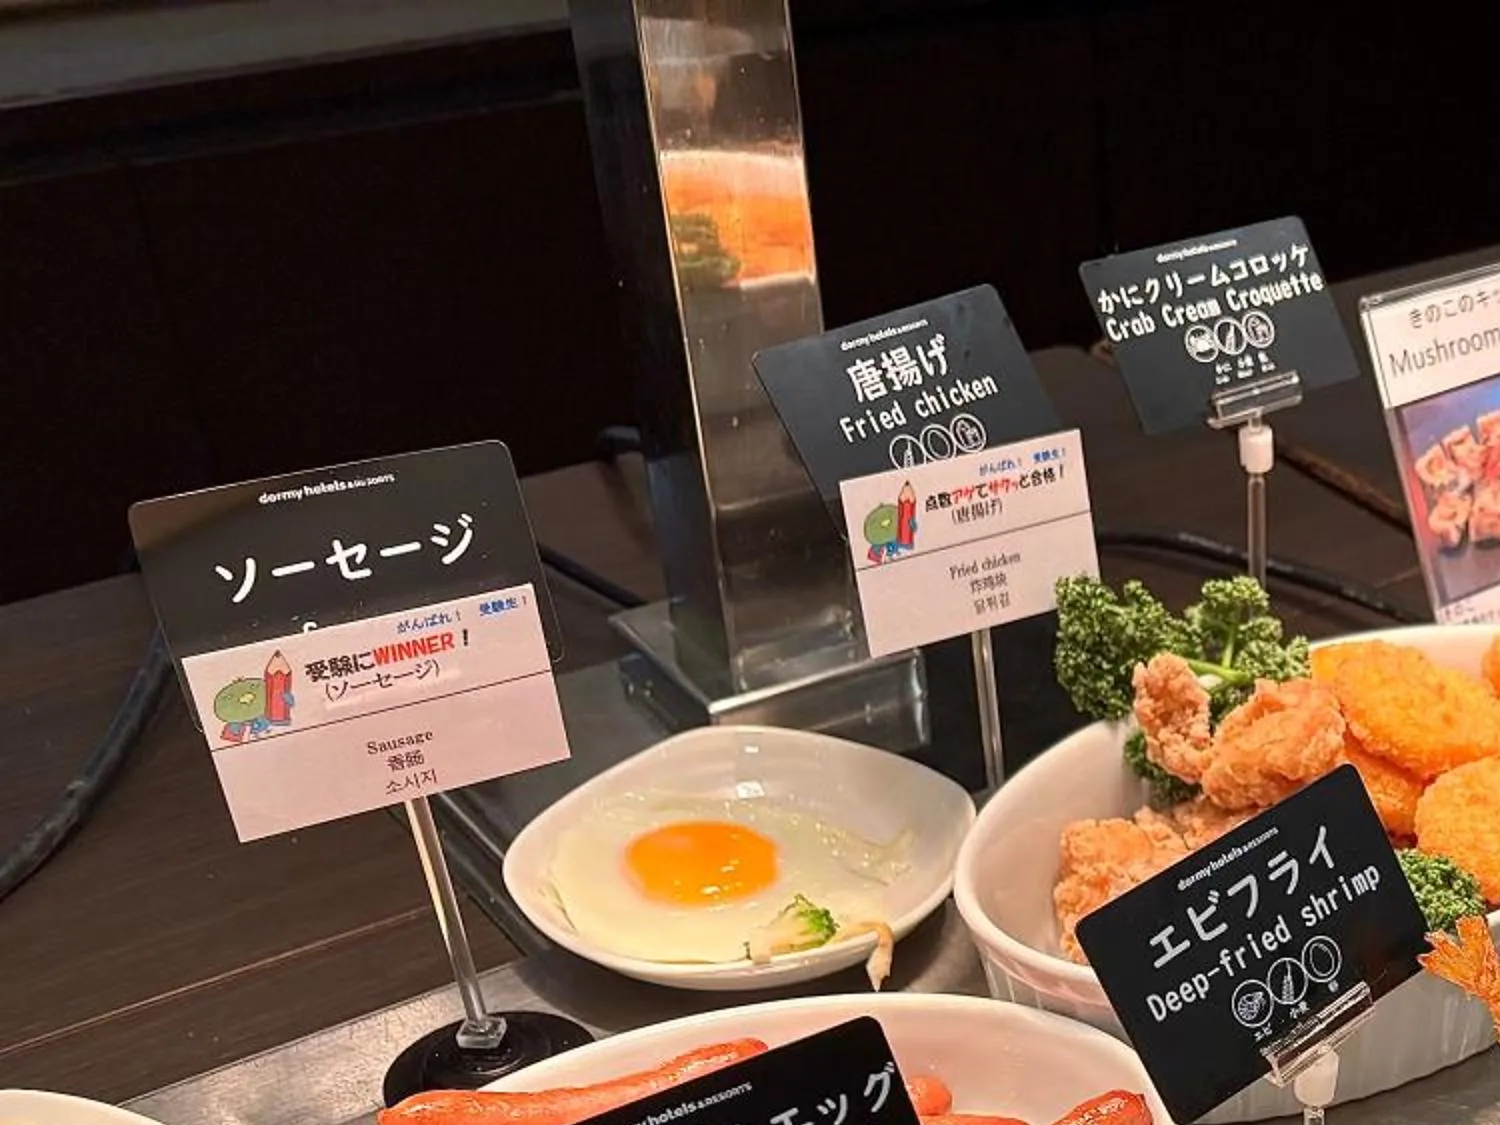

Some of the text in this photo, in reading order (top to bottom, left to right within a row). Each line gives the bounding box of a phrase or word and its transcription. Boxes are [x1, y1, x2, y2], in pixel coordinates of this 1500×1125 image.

[1097, 243, 1309, 315] かにクリームコロッケ
[1105, 271, 1325, 342] Crab Cream Croquette
[846, 333, 949, 404] 唐揚げ
[839, 374, 999, 444] Fried chicken
[258, 489, 303, 504] dormy
[303, 480, 347, 496] hotels
[214, 512, 474, 603] ソーセージ
[366, 731, 434, 756] Sausage
[385, 767, 437, 795] 소시지
[1149, 824, 1335, 970] エビフライ
[1145, 863, 1382, 1023] Deep-fried shrimp
